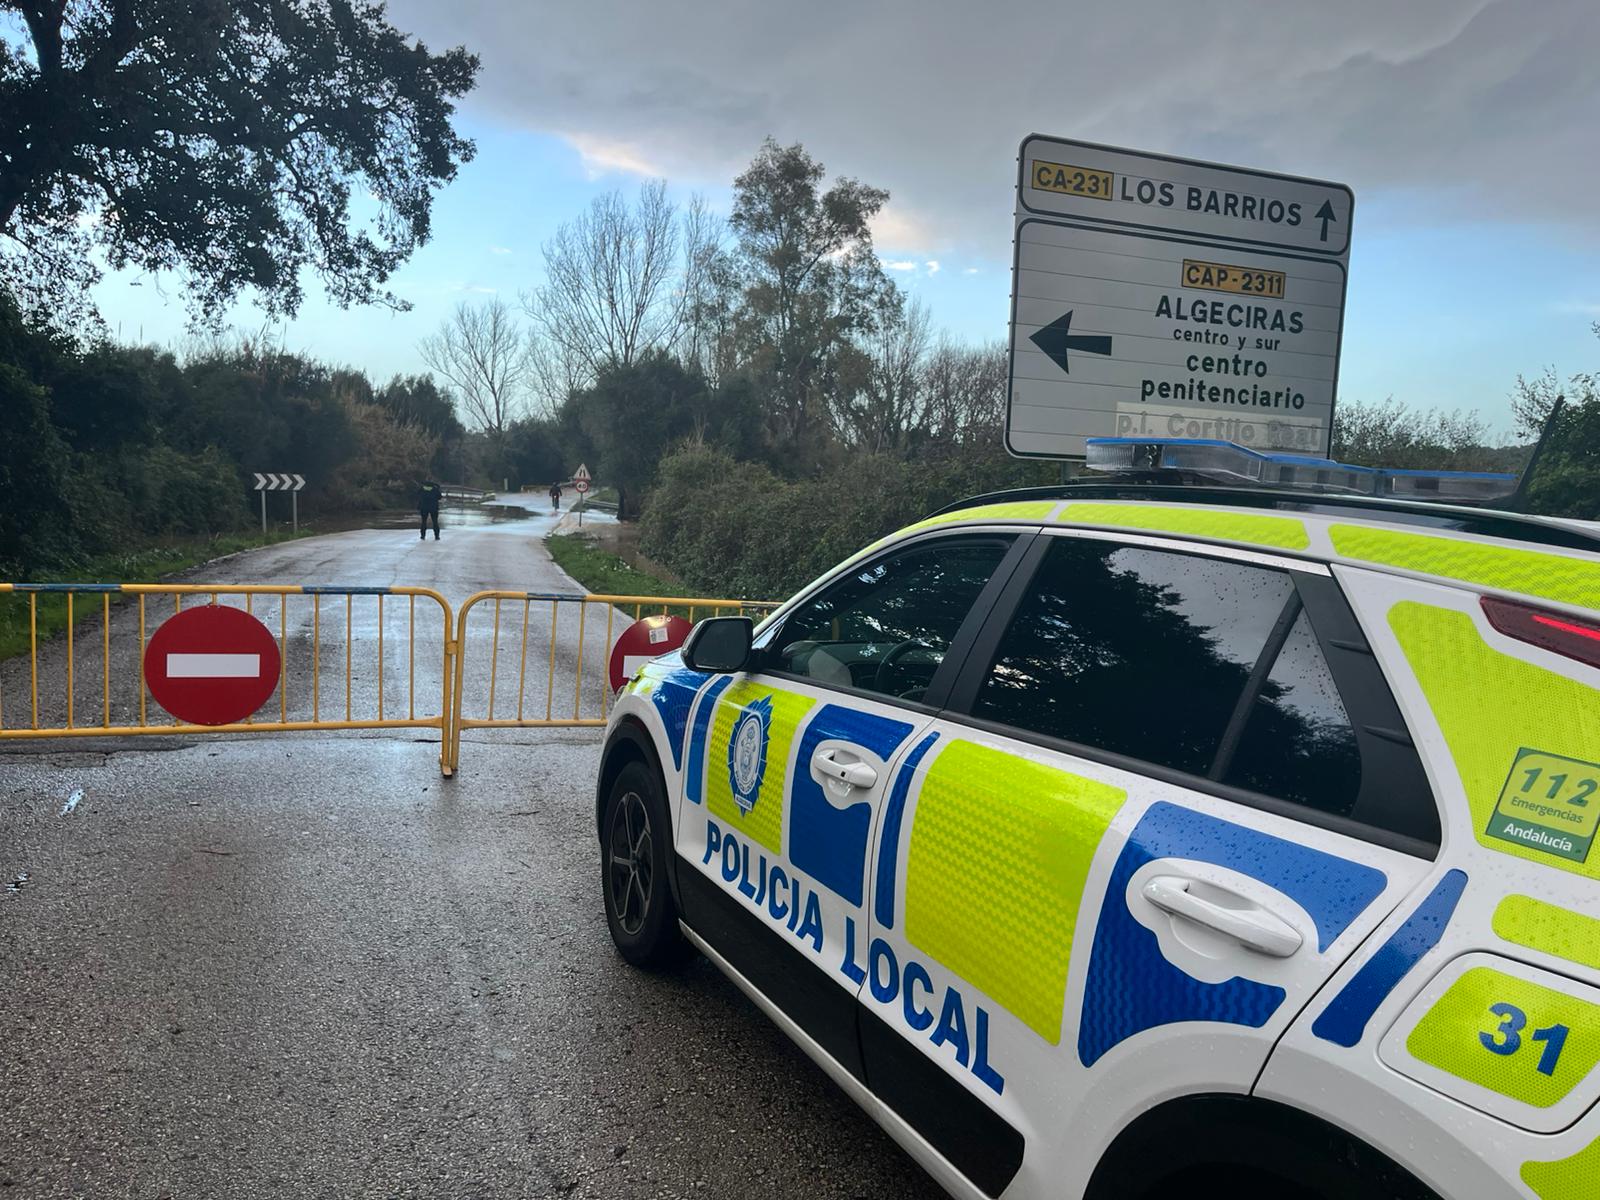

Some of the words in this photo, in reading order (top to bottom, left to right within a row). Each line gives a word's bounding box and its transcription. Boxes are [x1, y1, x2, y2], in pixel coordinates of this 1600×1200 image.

[1036, 166, 1110, 196] CA-231
[1120, 176, 1175, 206] LOS
[1186, 186, 1303, 226] BARRIOS
[1155, 295, 1304, 334] ALGECIRAS
[1173, 328, 1229, 345] centro
[1238, 336, 1246, 350] y
[1255, 337, 1280, 350] sur
[1186, 354, 1267, 377] centro
[1141, 378, 1305, 409] penitenciario
[1521, 767, 1598, 808] 112
[1511, 796, 1583, 824] Emergencias
[1503, 823, 1573, 852] Andalucía
[702, 820, 824, 953] POLICIA
[840, 916, 1005, 1097] LOCAL
[1478, 1002, 1570, 1077] 31
